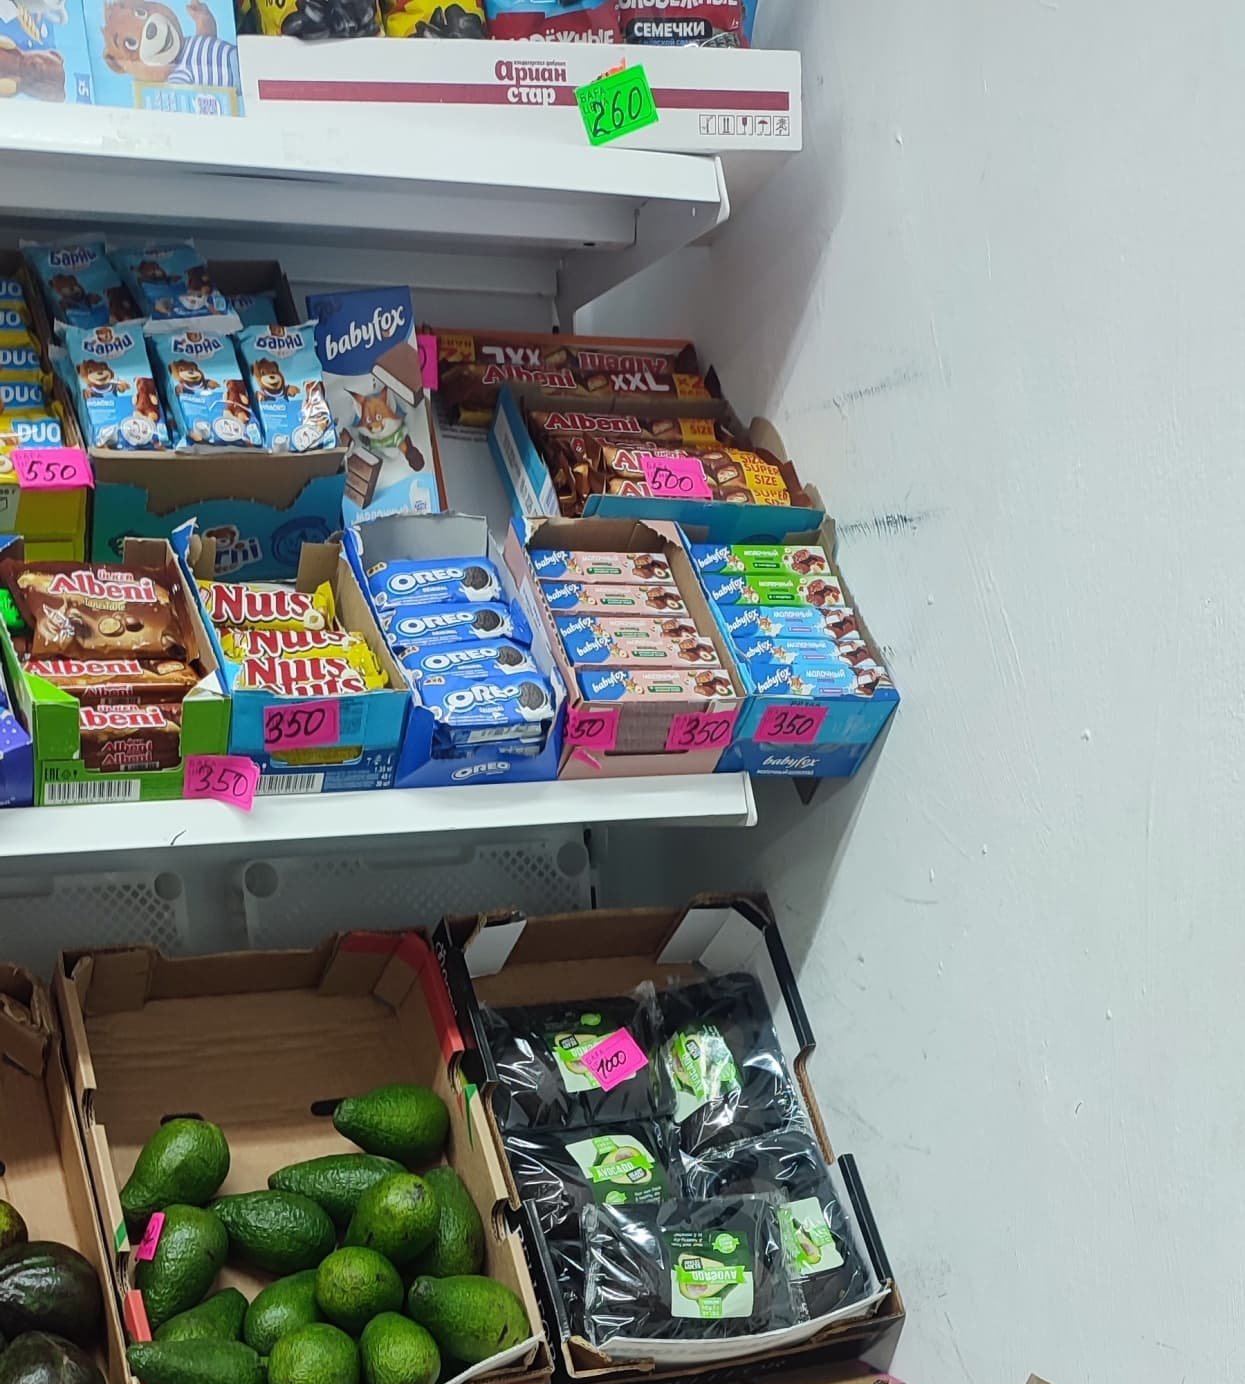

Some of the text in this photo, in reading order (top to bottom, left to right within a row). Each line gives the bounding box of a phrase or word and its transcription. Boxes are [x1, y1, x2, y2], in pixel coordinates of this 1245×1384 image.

[633, 20, 705, 38] СЕМЕЧКИ
[507, 86, 557, 106] стар
[591, 85, 643, 138] 260
[325, 303, 406, 361] babyfox
[611, 373, 670, 392] XXL
[17, 423, 61, 444] DUO
[545, 412, 642, 433] Albeni
[25, 461, 77, 482] 550
[650, 468, 694, 493] 500
[744, 464, 779, 476] SUPER
[754, 474, 778, 486] SIZE
[534, 549, 569, 570] babyfox
[698, 547, 731, 569] babyfox
[51, 571, 157, 602] Albeni
[391, 567, 465, 590] OREO
[712, 577, 746, 601] babyfox
[546, 583, 580, 602] babyfox
[210, 584, 314, 624] Nuts
[400, 612, 473, 634] OREO
[560, 616, 596, 637] babyfox
[727, 609, 761, 634] babyfox
[246, 629, 347, 657] Nuts
[577, 636, 612, 657] babyfox
[424, 648, 499, 671] OREO
[592, 671, 628, 693] babyfox
[757, 667, 793, 694] babyfox
[264, 707, 326, 745] 350
[678, 720, 730, 746] 350
[768, 712, 815, 737] 350
[452, 762, 509, 780] OREO
[762, 756, 820, 769] babyfox
[195, 766, 248, 797] 350
[597, 1050, 627, 1077] 1000
[691, 1269, 738, 1281] AVOCADO
